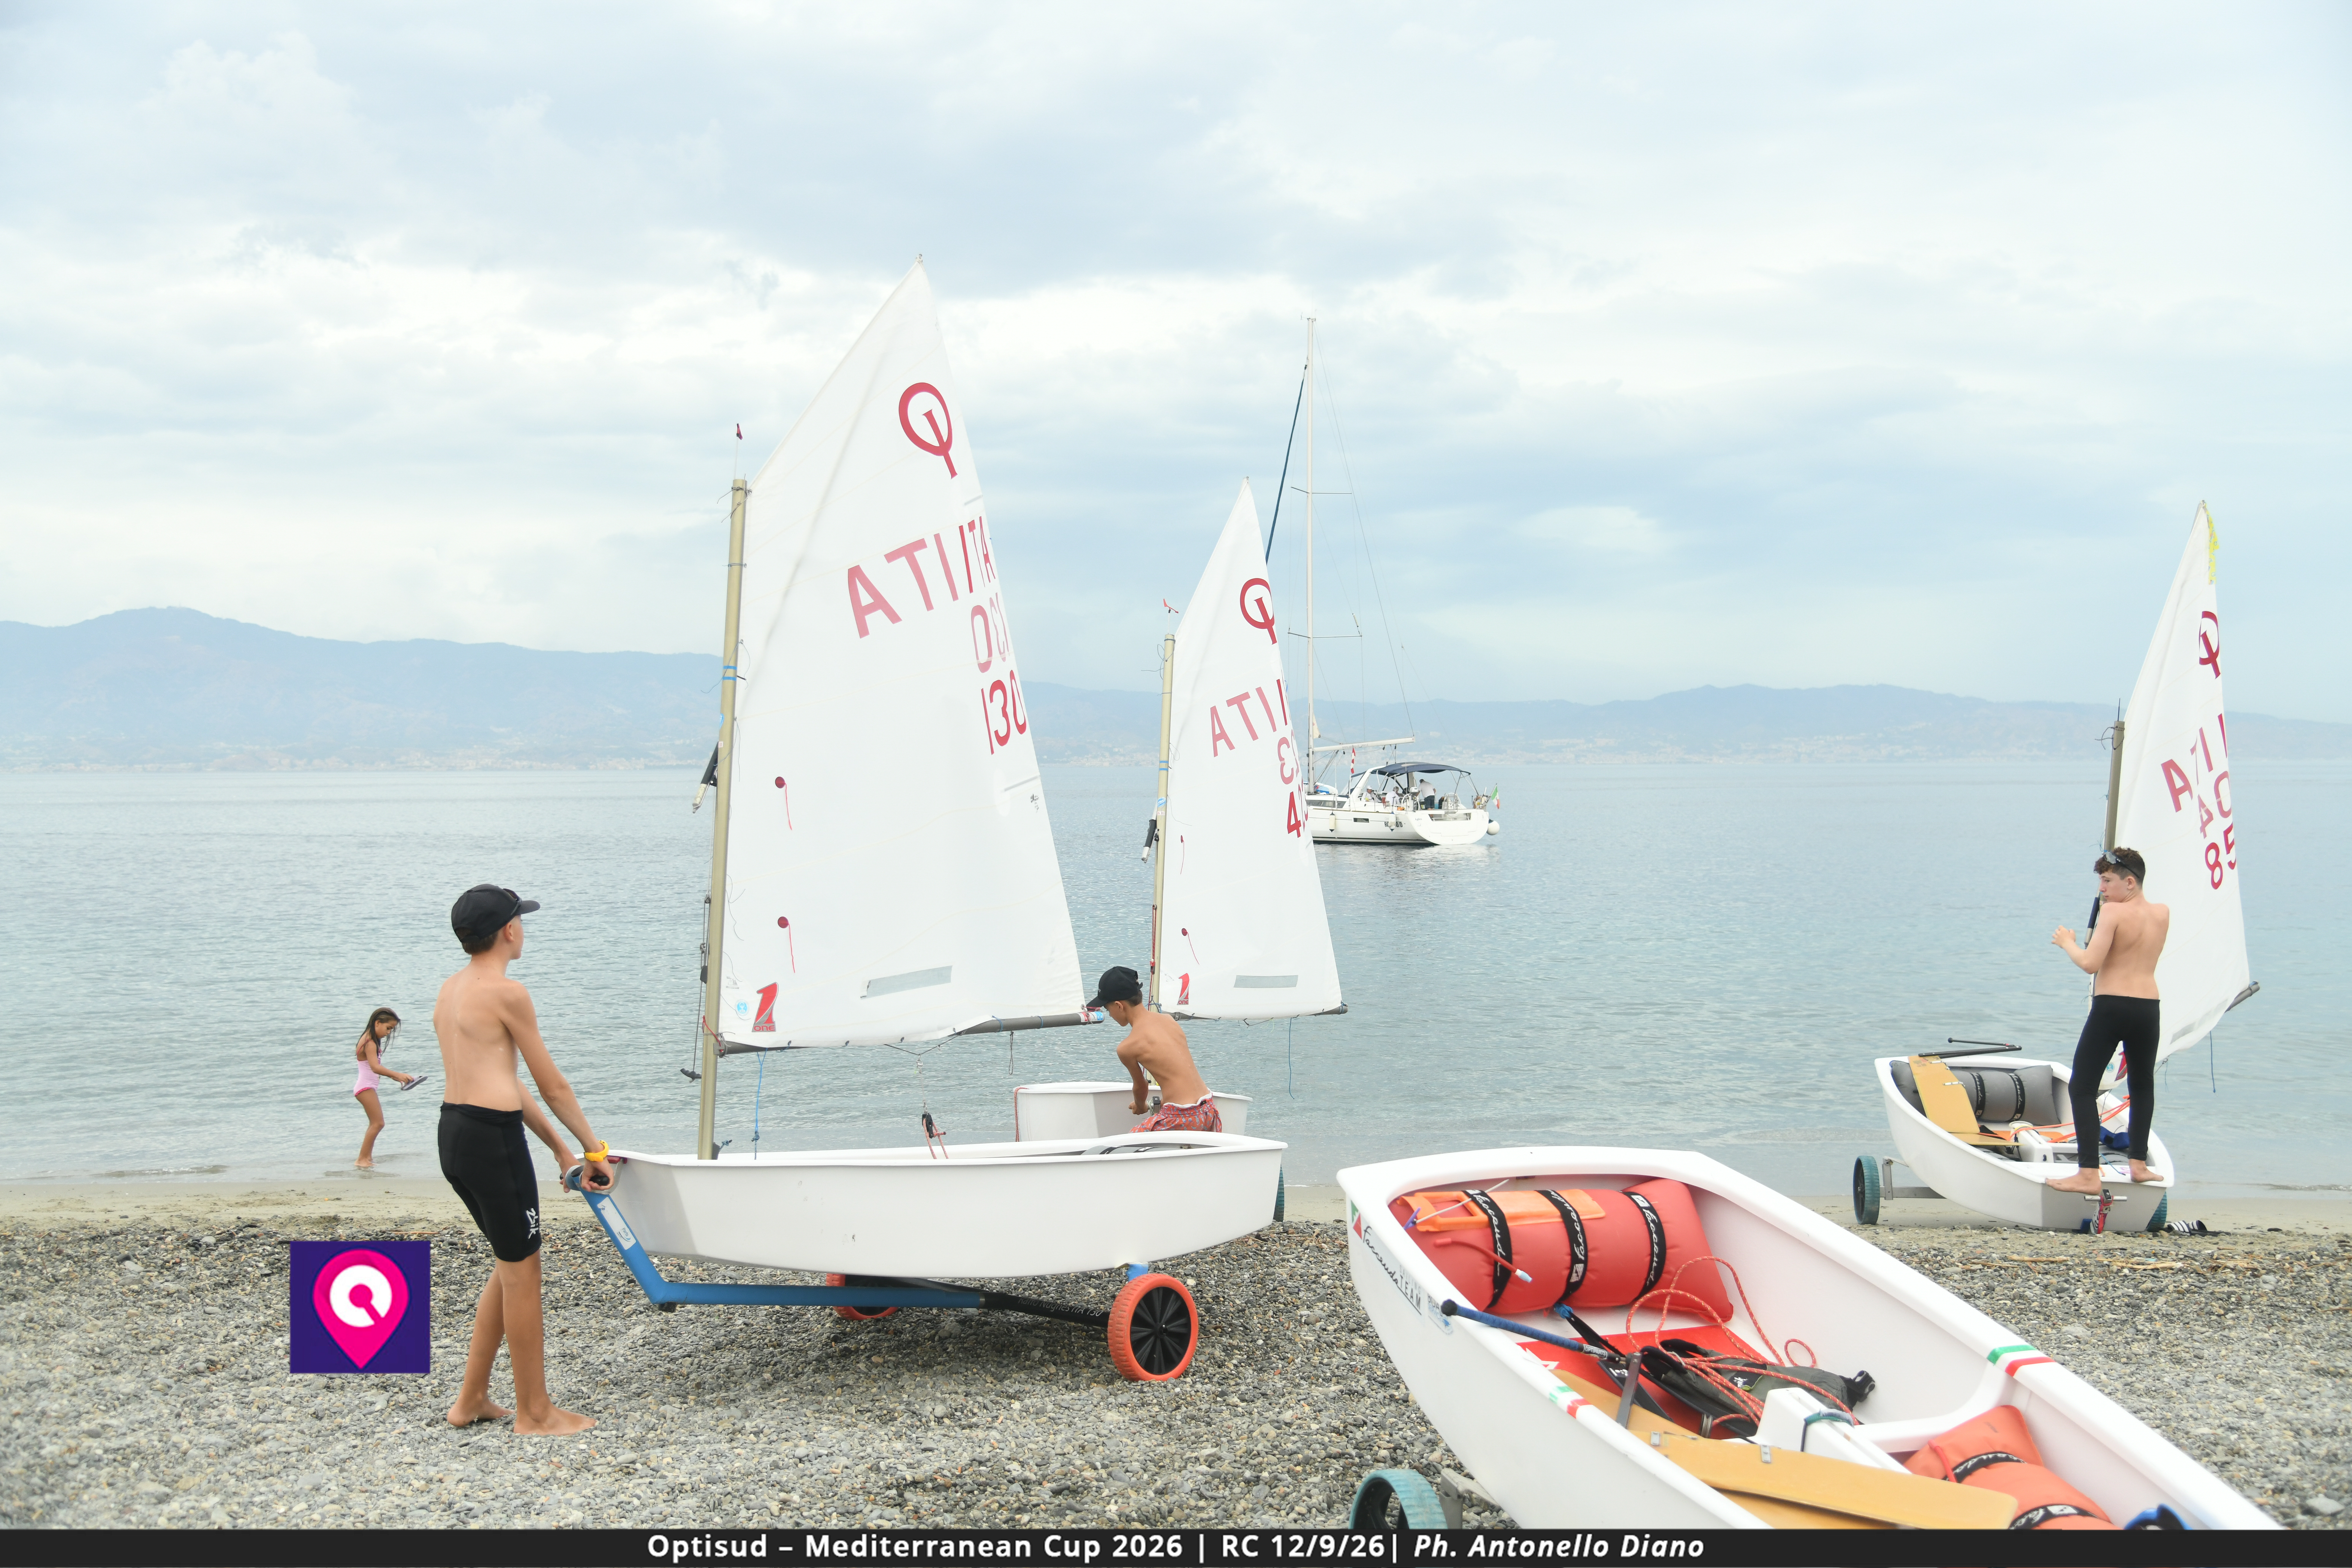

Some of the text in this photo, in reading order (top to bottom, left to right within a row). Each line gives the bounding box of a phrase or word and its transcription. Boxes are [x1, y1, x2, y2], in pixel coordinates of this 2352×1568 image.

[981, 670, 1026, 755] 130
[1400, 1274, 1421, 1310] TEAM
[1585, 1346, 1606, 1356] OPTIPARTS
